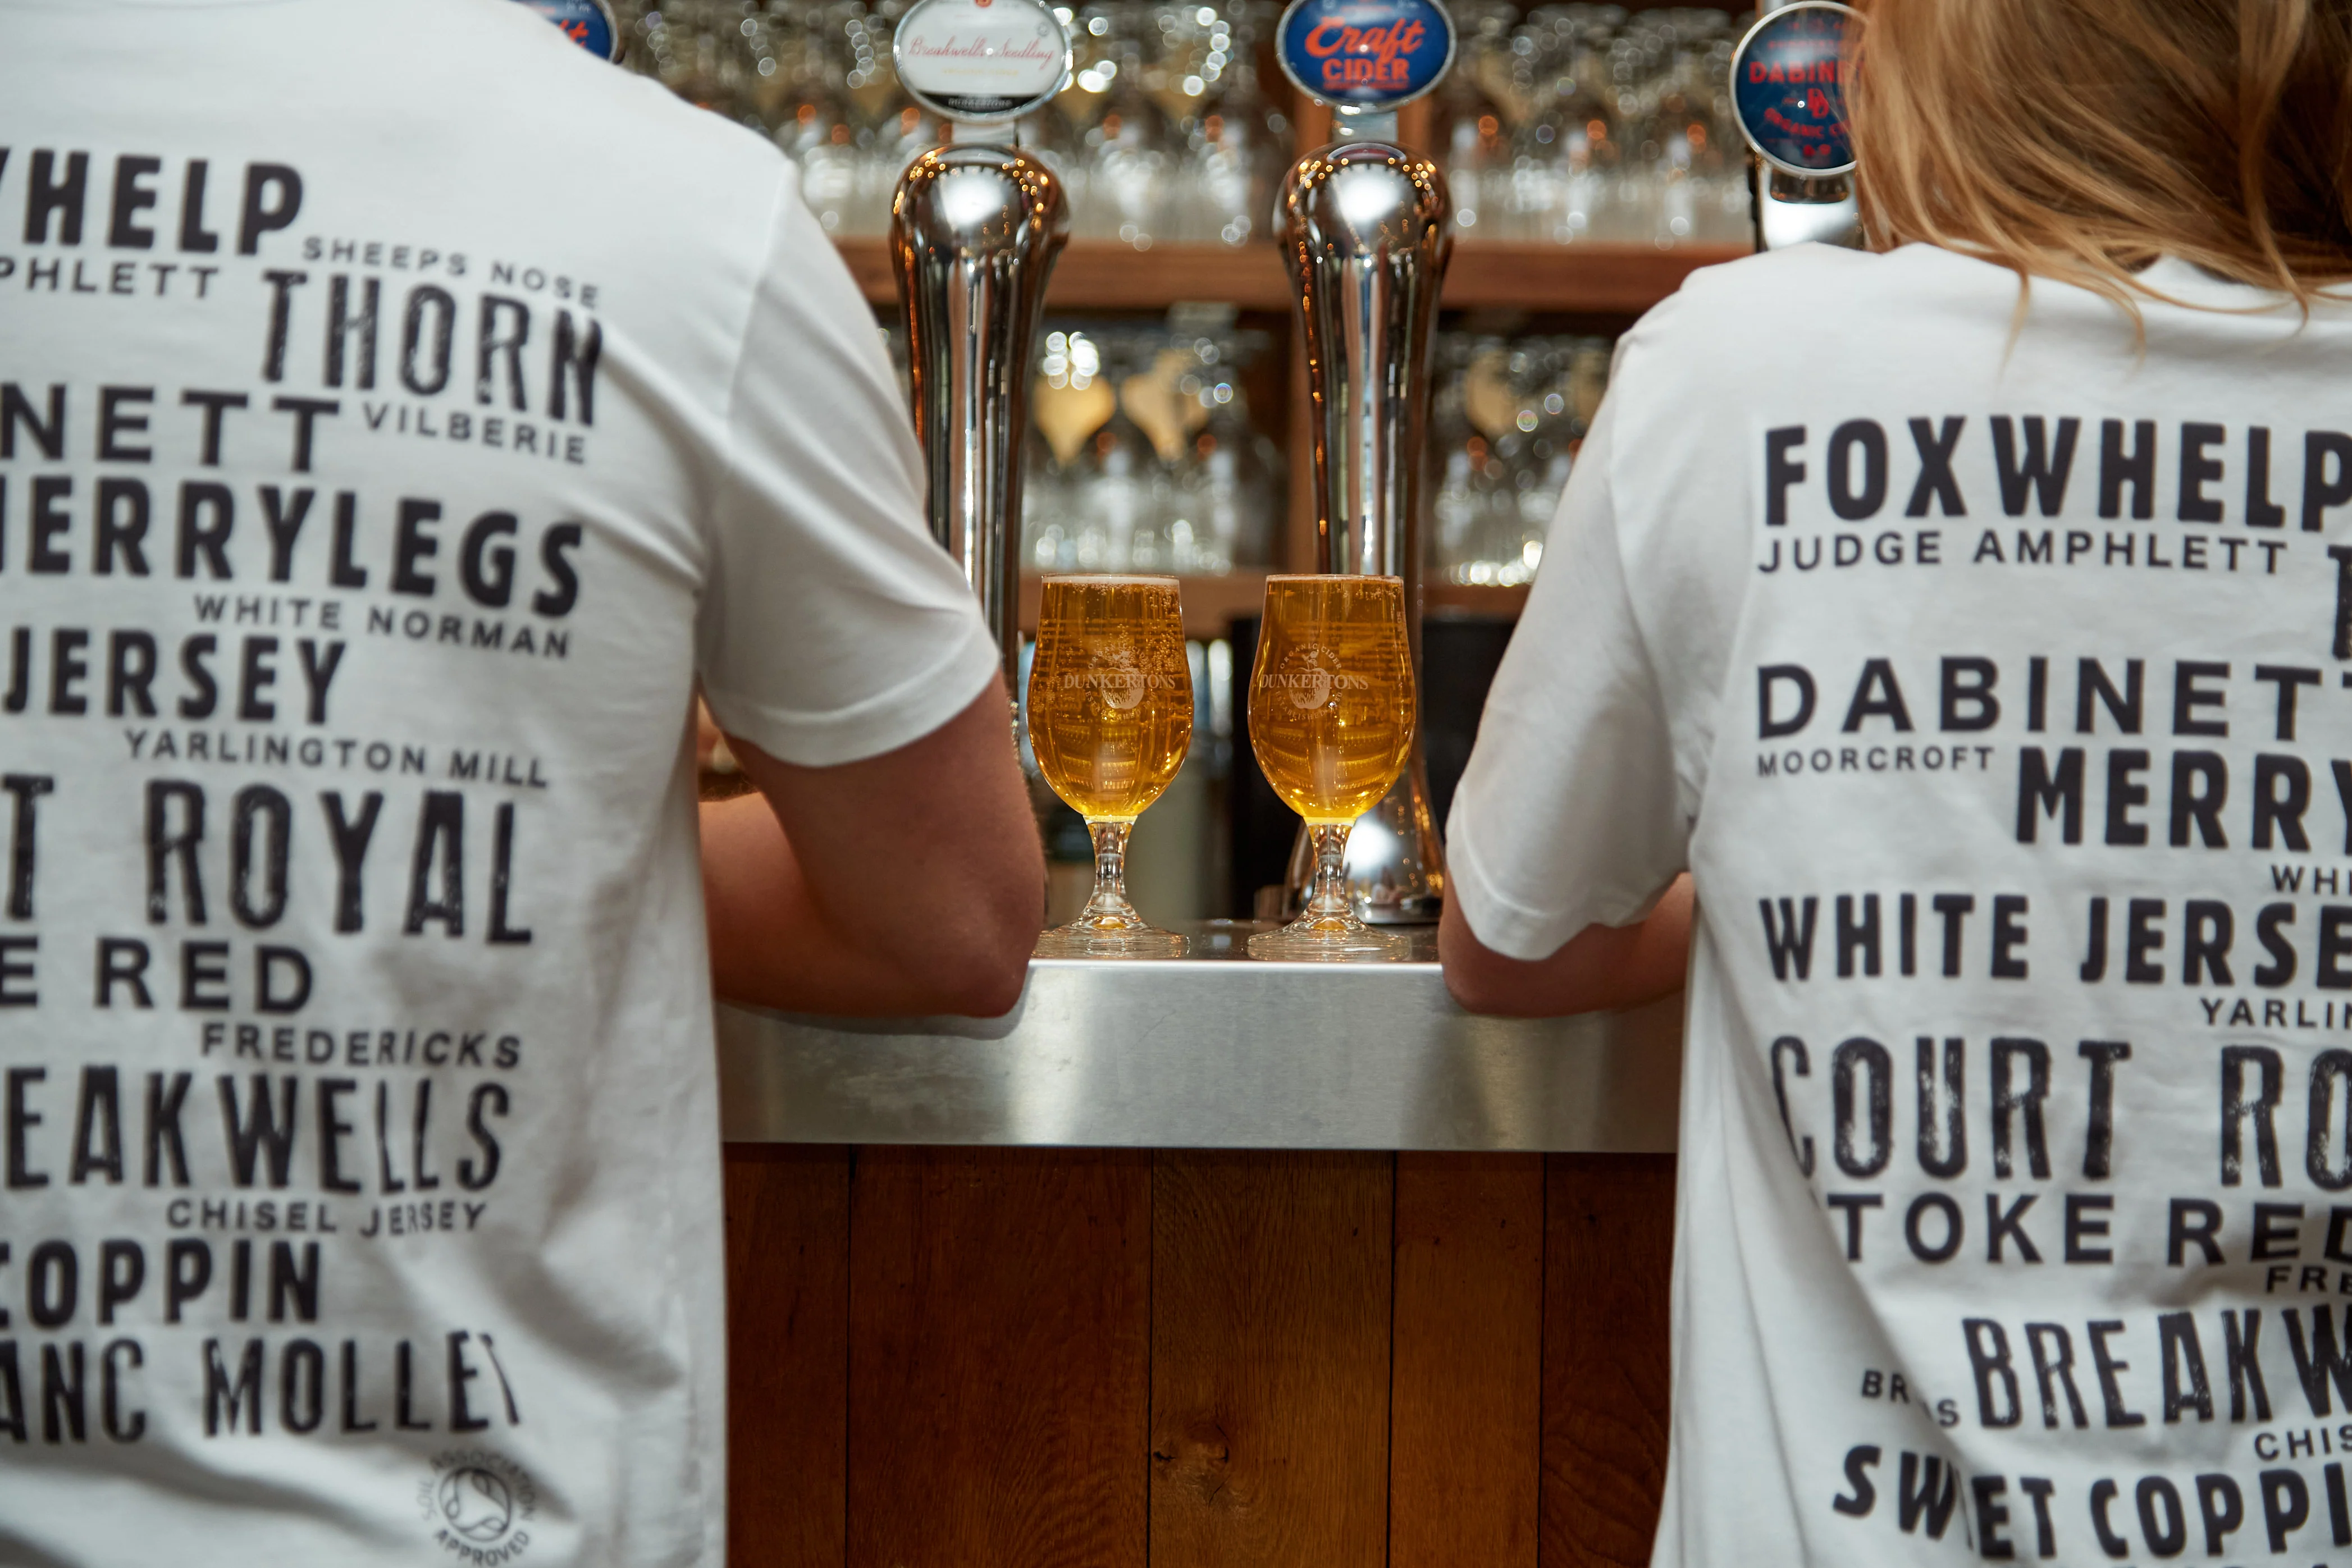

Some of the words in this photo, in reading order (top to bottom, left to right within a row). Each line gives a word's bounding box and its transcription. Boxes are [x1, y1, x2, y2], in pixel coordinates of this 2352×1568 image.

[1304, 16, 1426, 63] Craft
[1322, 58, 1410, 80] CIDER
[1748, 60, 1865, 84] DABIN
[0, 146, 304, 256] HELP
[302, 236, 468, 276] SHEEPS
[491, 261, 600, 309] NOSE
[262, 269, 602, 426] THORN
[364, 401, 586, 464] VILBERIE
[1765, 415, 2352, 532] FOXWHELP
[0, 476, 582, 618] ERRYLEGS
[1757, 531, 1943, 574] JUDGE
[1974, 529, 2288, 574] AMPHLETT
[194, 595, 342, 628] WHITE
[367, 606, 570, 659] NORMAN
[1280, 643, 1318, 669] ORGANIC
[1321, 646, 1342, 670] CIDER
[2, 627, 346, 725] JERSEY
[1064, 674, 1175, 689] DUNKERTONS
[1261, 674, 1368, 690] DUNKERTONS
[1756, 656, 2352, 742] DABINET
[125, 729, 426, 774] YARLINGTON
[449, 751, 547, 788] MILL
[1756, 746, 1995, 777] MOORCROFT
[144, 778, 532, 944] ROYAL
[1759, 894, 2029, 981] WHITE
[94, 938, 314, 1013] RED
[201, 1022, 522, 1069] FREDERICKS
[2199, 997, 2352, 1030] YARLI
[4, 1065, 510, 1195] EAKWELLS
[1770, 1035, 2132, 1181] COURT
[166, 1199, 337, 1233] CHISEL
[360, 1200, 487, 1238] JERSEY
[1826, 1192, 2116, 1264] TOKE
[0, 1239, 321, 1329] OPPIN
[202, 1331, 521, 1438] MOLLE
[1961, 1304, 2352, 1429] BREAKW
[1832, 1444, 2057, 1561] SWET
[2090, 1462, 2352, 1559] COPPI
[433, 1529, 529, 1567] APPROVED
